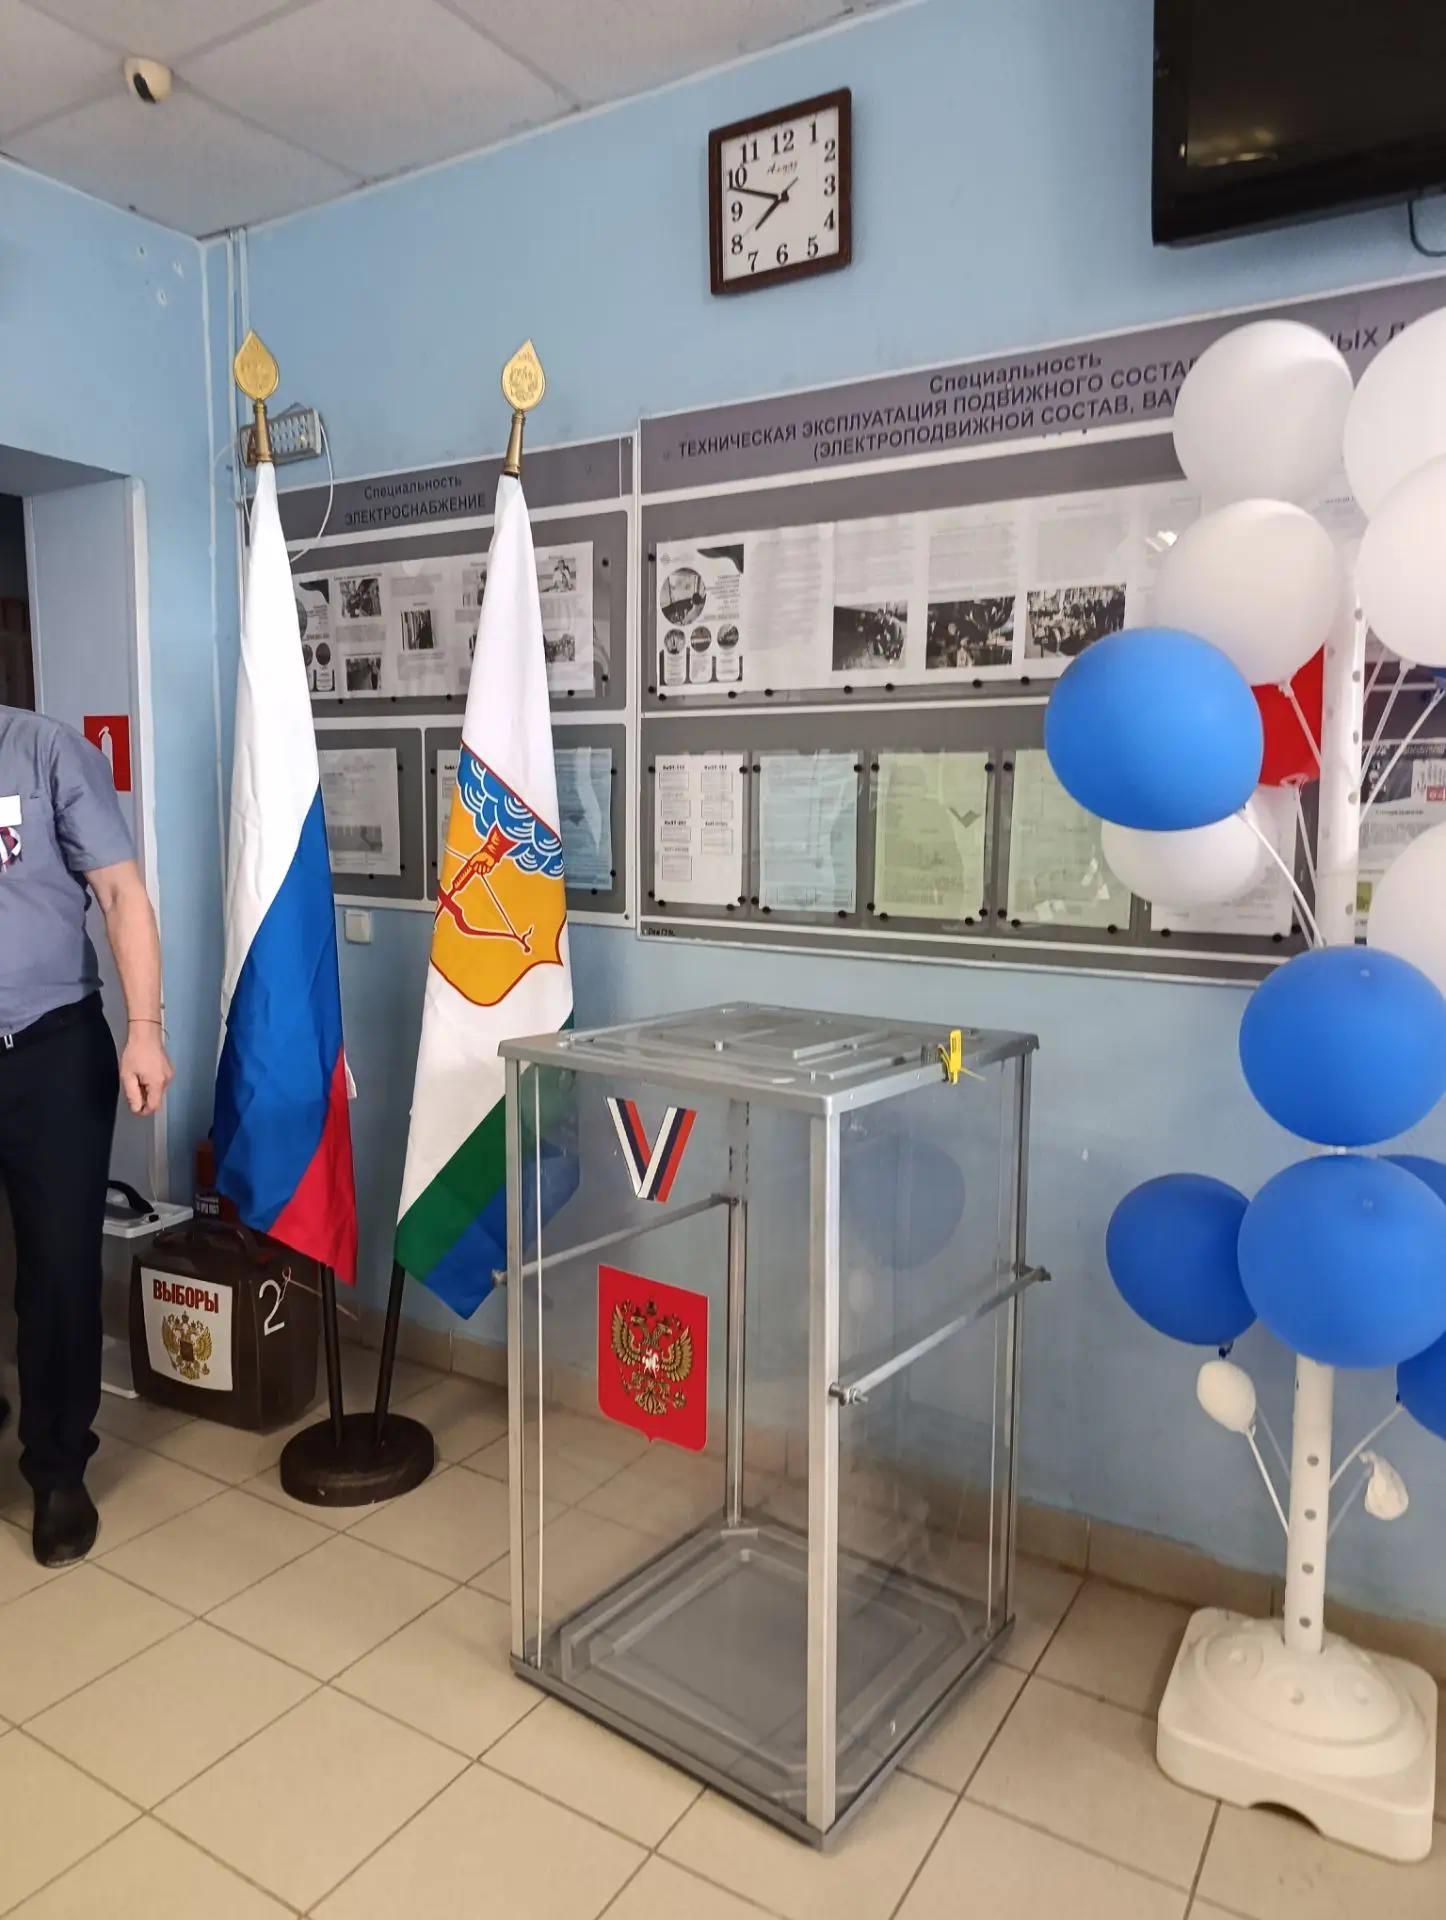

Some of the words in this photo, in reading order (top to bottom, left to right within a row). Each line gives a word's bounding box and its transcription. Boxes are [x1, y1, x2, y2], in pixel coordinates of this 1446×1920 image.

[771, 129, 794, 156] 12
[809, 119, 818, 145] 1
[741, 140, 760, 165] 11
[824, 139, 836, 163] 2
[728, 166, 748, 191] 10
[824, 175, 836, 197] 3
[731, 201, 743, 222] 9
[824, 209, 835, 231] 4
[731, 234, 743, 255] 8
[776, 244, 789, 265] 6
[807, 236, 819, 257] 5
[748, 250, 759, 272] 7
[930, 352, 1102, 394] Специальность
[679, 424, 797, 459] ТЕХНИЧЕСКАЯ
[802, 400, 947, 439] ЭКСПЛУАТАЦИЯ
[954, 374, 1103, 413] ПОДВИЖНОГО
[813, 410, 1034, 462] (ЭЛЕКТРОПОДВИЖНОЙ
[1041, 396, 1135, 425] СОСТАВ,
[364, 474, 462, 499] Специальность
[344, 492, 486, 527] ЭЛЕКТРОСНАБЖЕНИЕ
[153, 1278, 219, 1314] ВЫБОРЫ
[259, 1279, 285, 1336] 2
